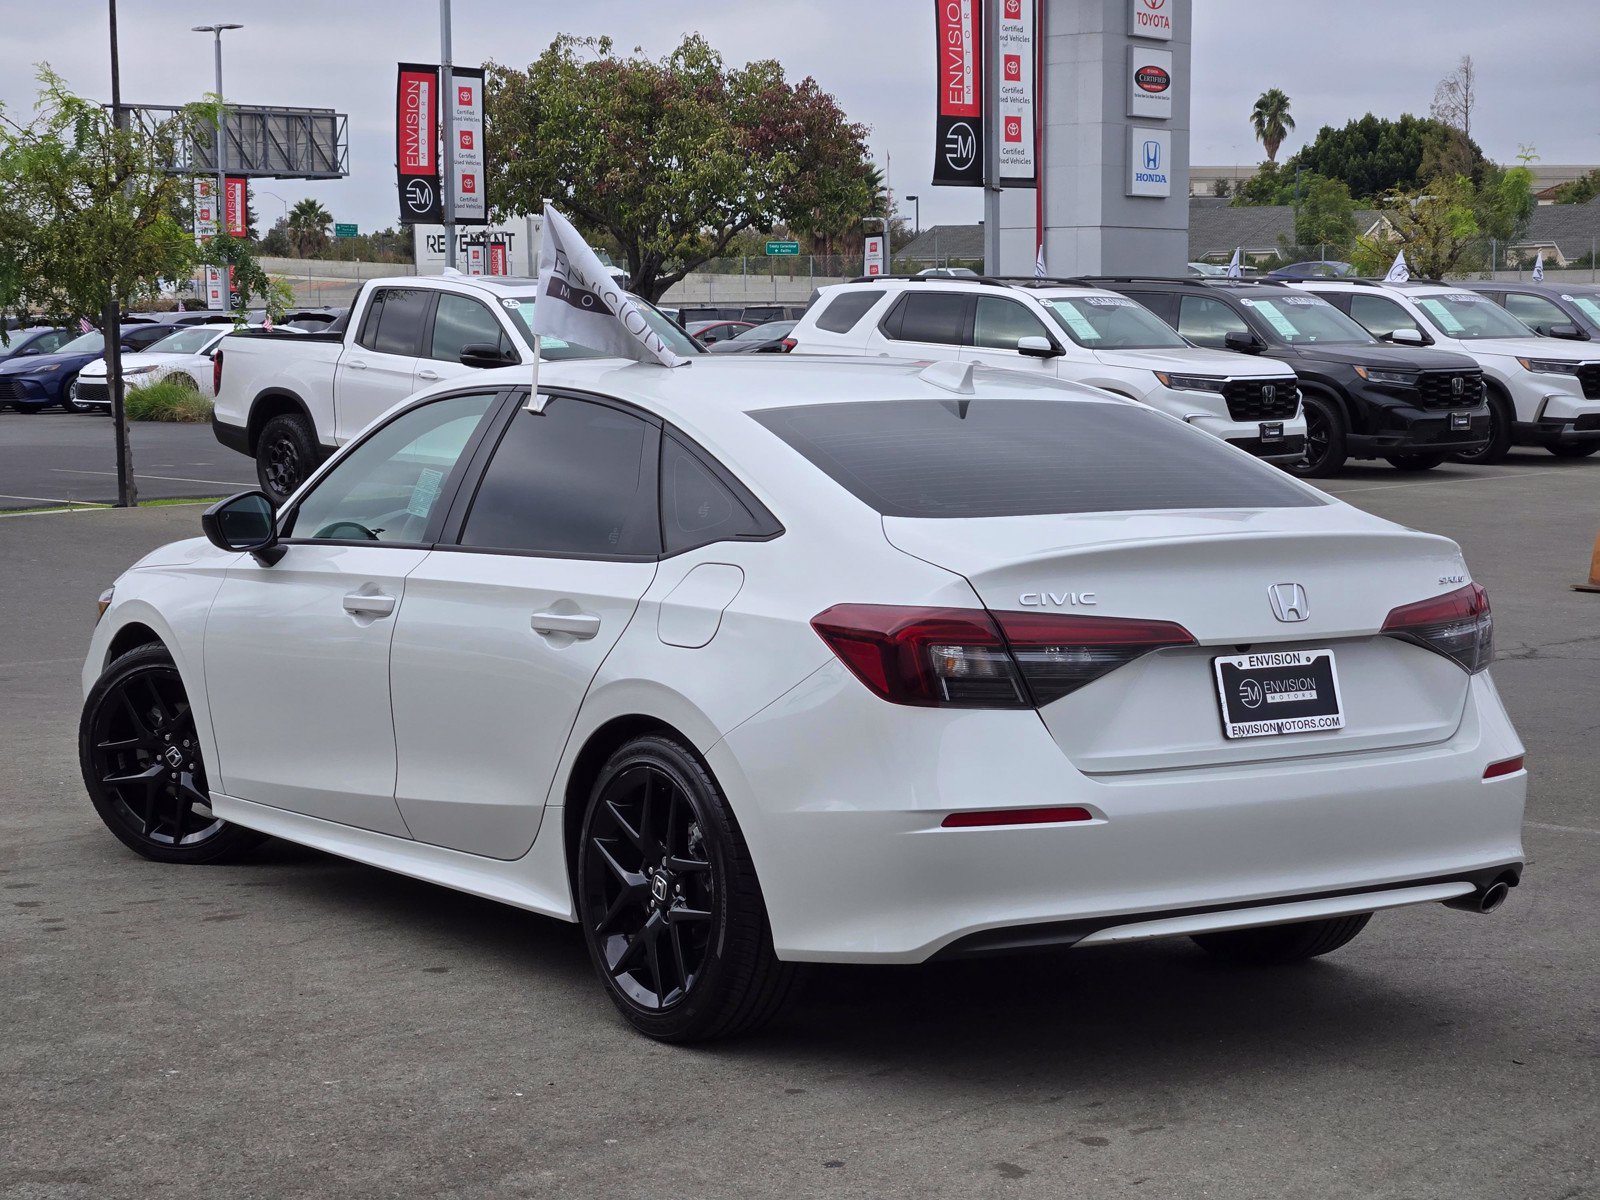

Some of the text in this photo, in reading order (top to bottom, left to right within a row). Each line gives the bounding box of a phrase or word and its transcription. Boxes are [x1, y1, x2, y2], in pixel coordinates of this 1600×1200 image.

[1137, 12, 1170, 29] TOYOTA
[1002, 24, 1024, 33] Certified
[1010, 35, 1030, 43] Vehicles
[947, 3, 963, 104] ENVISIO
[1002, 86, 1024, 94] Certified
[1010, 96, 1031, 104] Vehicles
[407, 80, 419, 166] ENVISION
[1002, 147, 1025, 155] Certified
[1010, 157, 1031, 165] Vehicles
[1135, 172, 1167, 183] HONDA
[1019, 592, 1097, 606] CIVIC
[1249, 653, 1300, 667] ENVISION
[1263, 677, 1316, 694] ENVISION
[1270, 692, 1313, 701] MOTORS
[1232, 716, 1341, 736] ENVISIONMOTORS.COM
